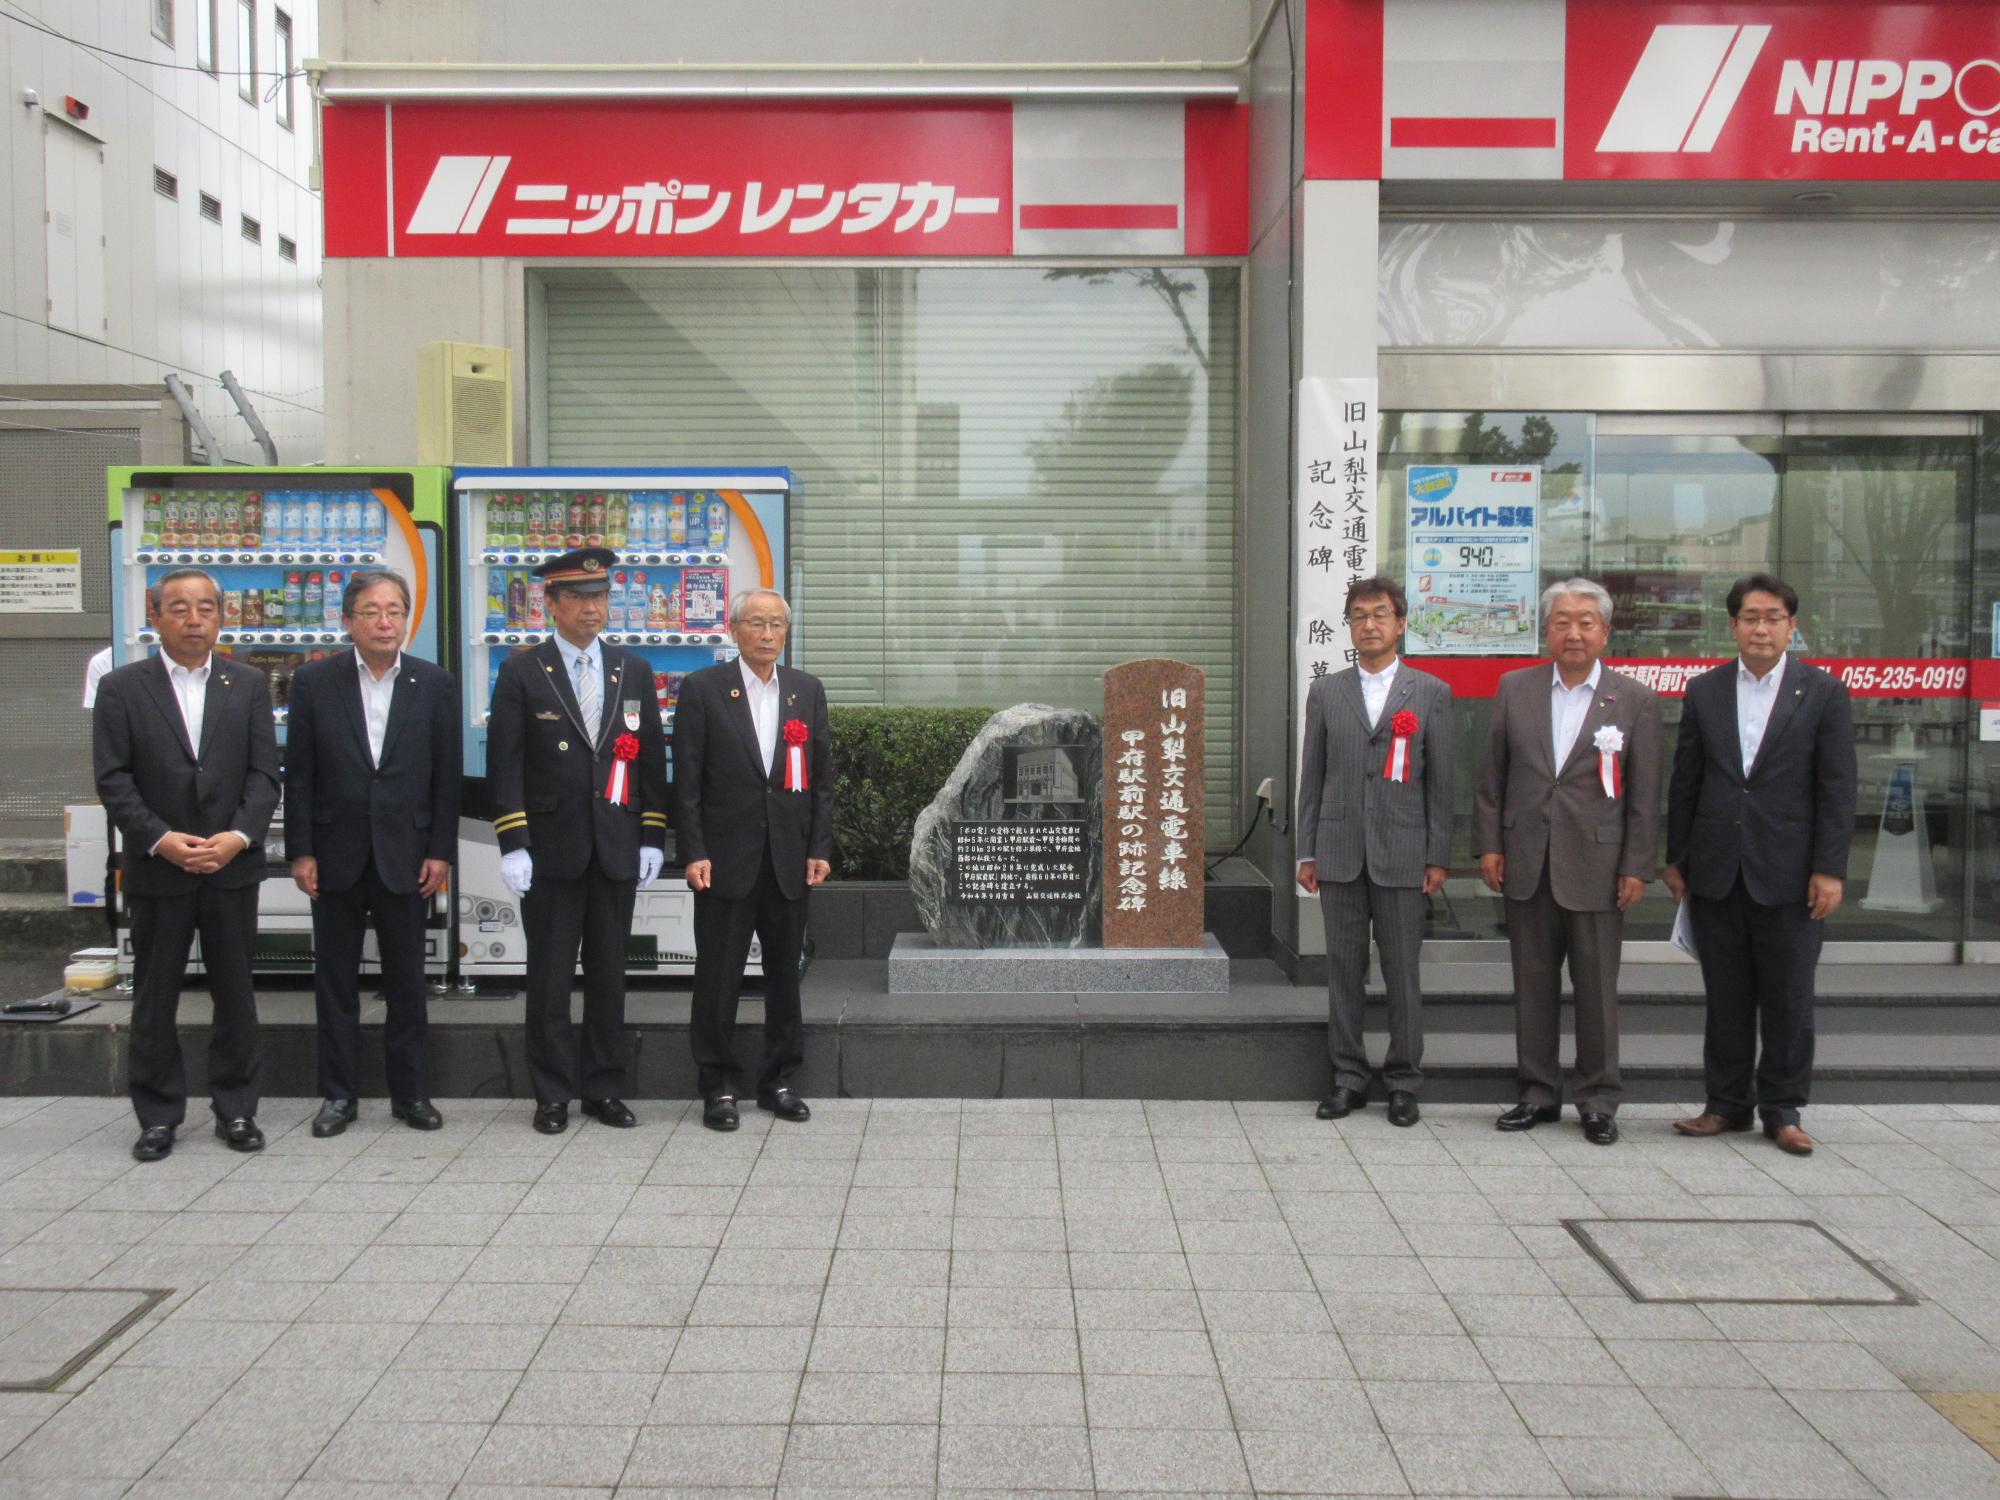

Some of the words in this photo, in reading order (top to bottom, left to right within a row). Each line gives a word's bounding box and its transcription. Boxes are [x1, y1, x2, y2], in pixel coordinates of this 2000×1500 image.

[1774, 59, 2000, 117] NIPPO
[504, 178, 731, 236] ニッポン
[740, 180, 1000, 235] レンタカー
[1410, 505, 1535, 529] アルバイト募集
[17, 553, 55, 563] お願い
[1459, 546, 1493, 567] 940
[1841, 665, 1967, 690] 055-235-0919
[1159, 687, 1190, 892] 旧山梨交通電車線
[1116, 729, 1148, 913] 甲府駅前駅の跡記念碑
